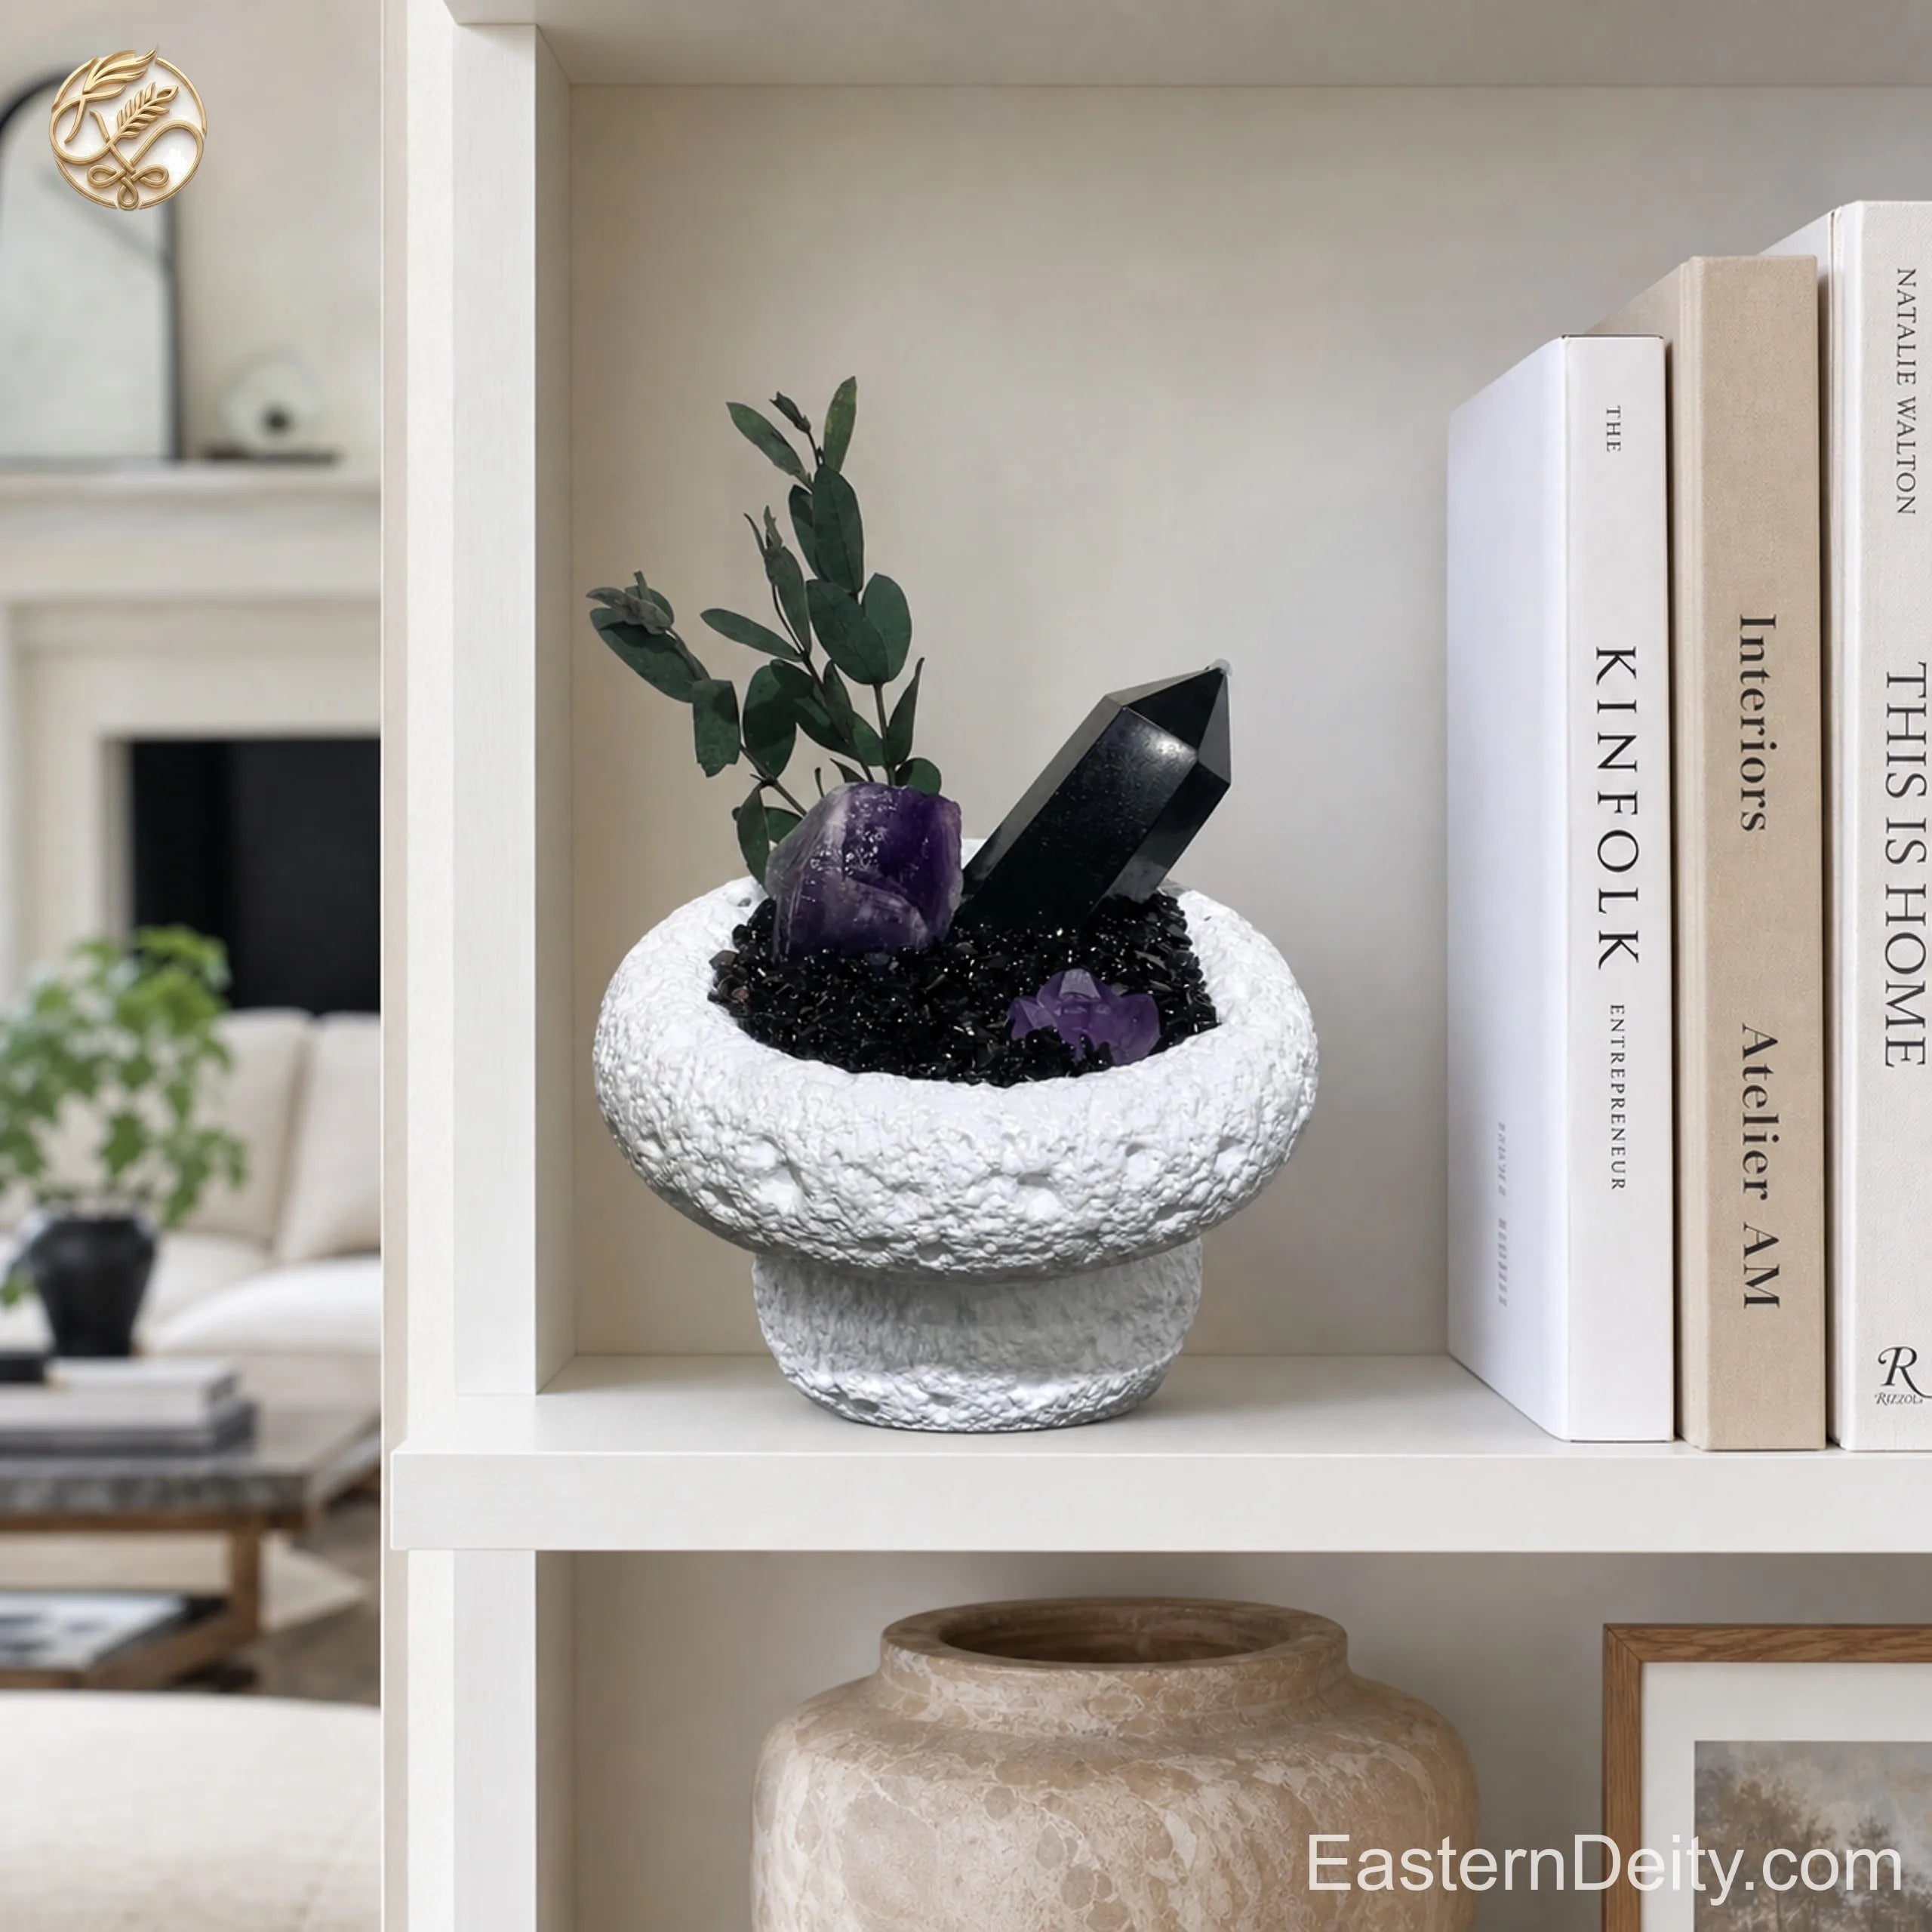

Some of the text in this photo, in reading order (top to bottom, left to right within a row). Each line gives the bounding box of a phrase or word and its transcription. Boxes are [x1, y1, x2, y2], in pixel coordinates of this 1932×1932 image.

[1606, 405, 1622, 453] THE
[1896, 268, 1917, 515] NATALIE WALTON
[1595, 645, 1640, 971] KINFOLK
[1739, 614, 1778, 832] Interiors
[1884, 661, 1928, 1068] THIS IS HOME
[1610, 1004, 1626, 1190] ENTREPRENEUR
[1742, 1023, 1780, 1309] Atelier AM
